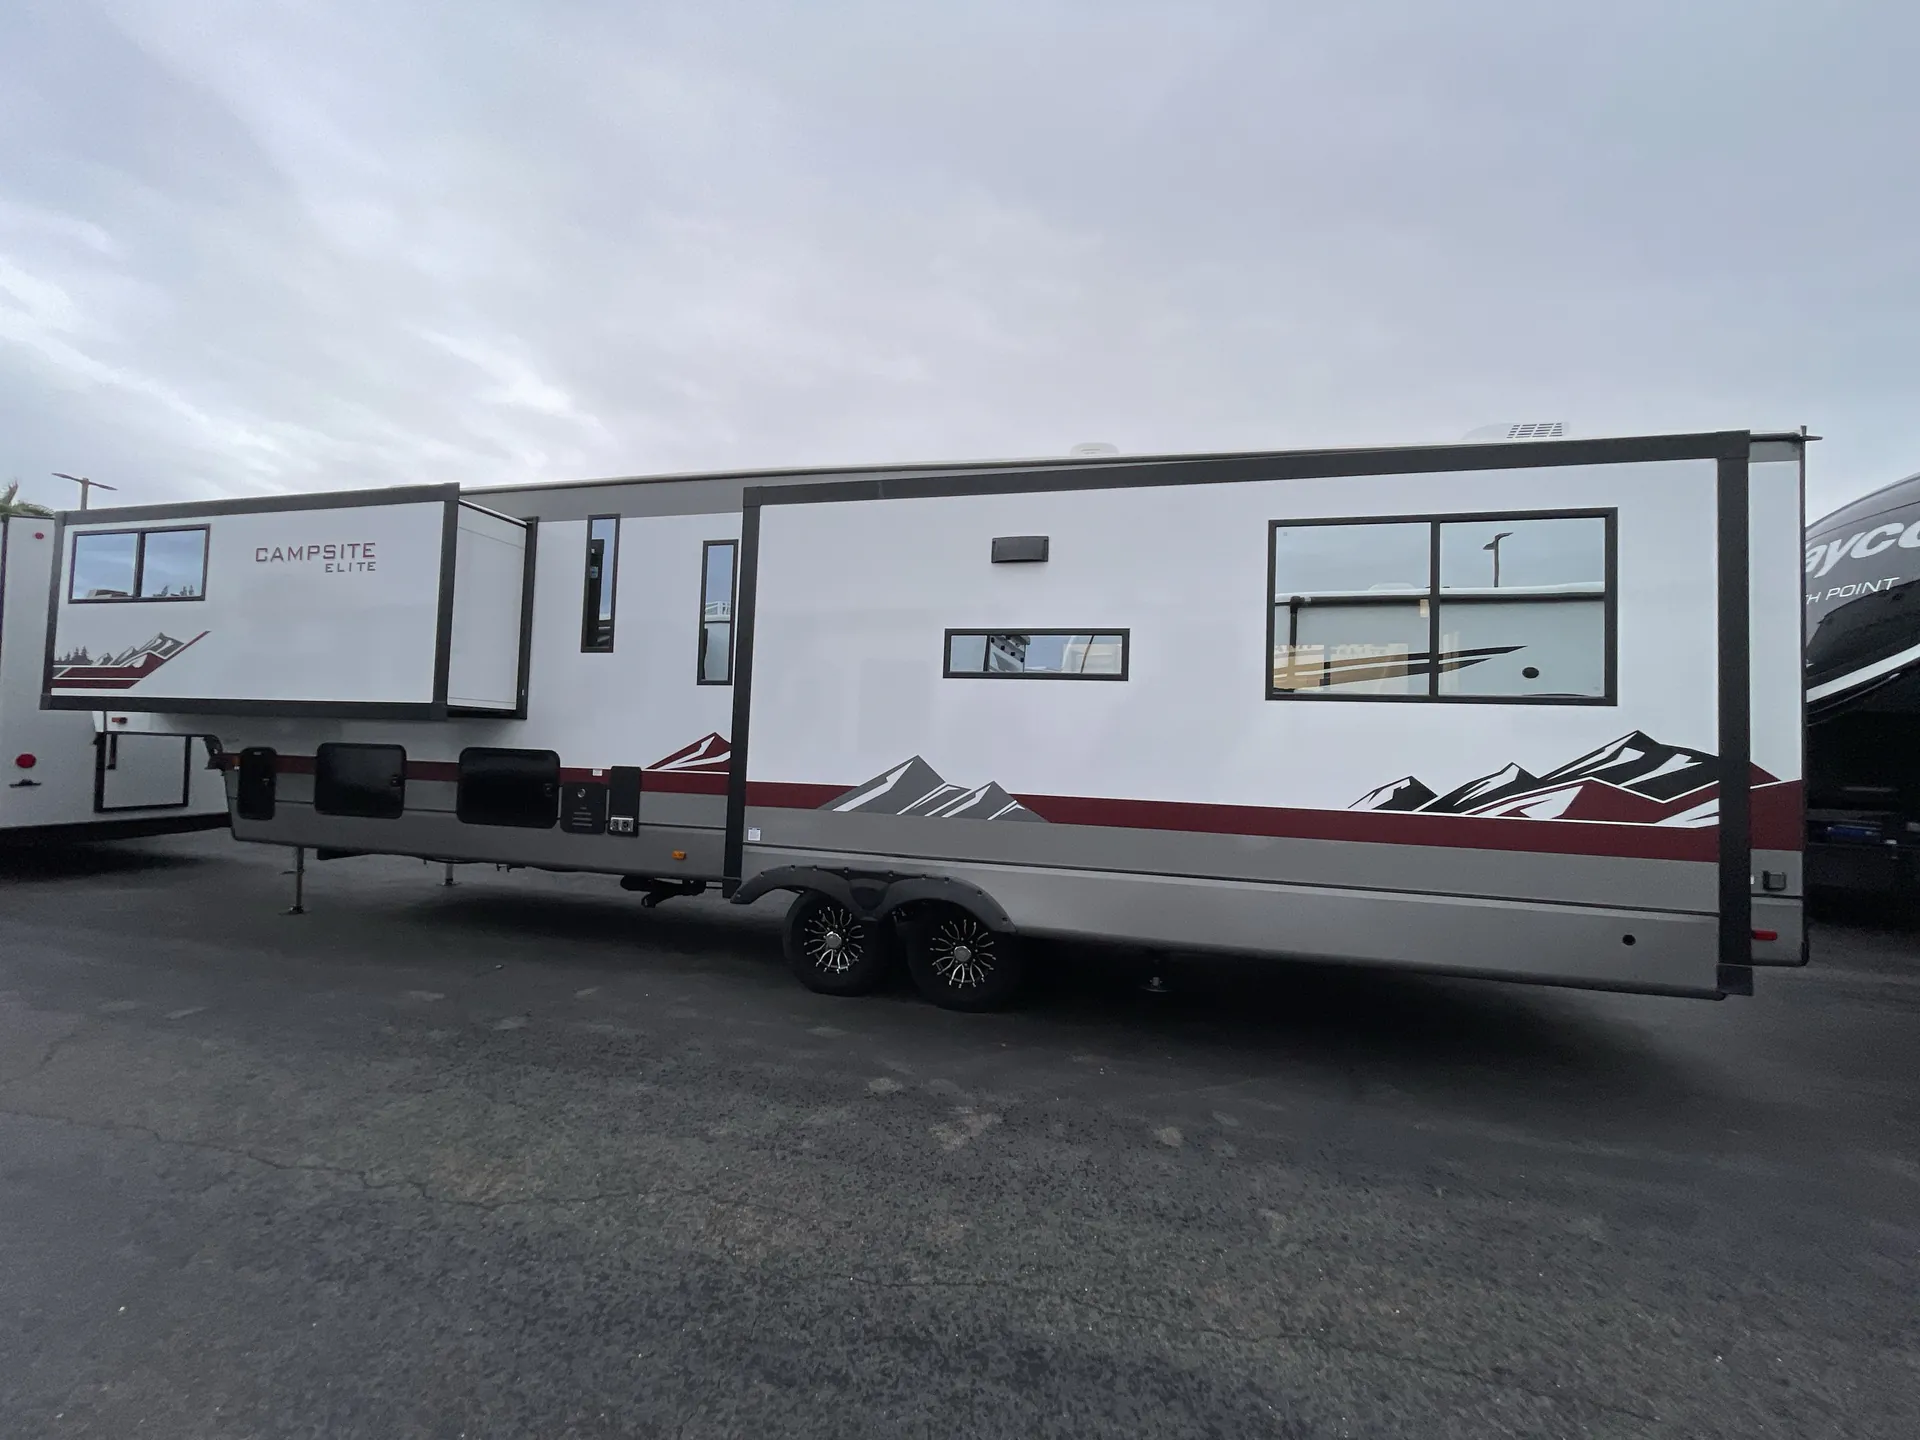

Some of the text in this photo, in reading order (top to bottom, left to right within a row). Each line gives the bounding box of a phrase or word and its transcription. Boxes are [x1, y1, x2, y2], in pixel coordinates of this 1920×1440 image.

[256, 543, 376, 562] CAMPSITE
[325, 562, 376, 573] ELITE
[1825, 577, 1900, 601] POINT
